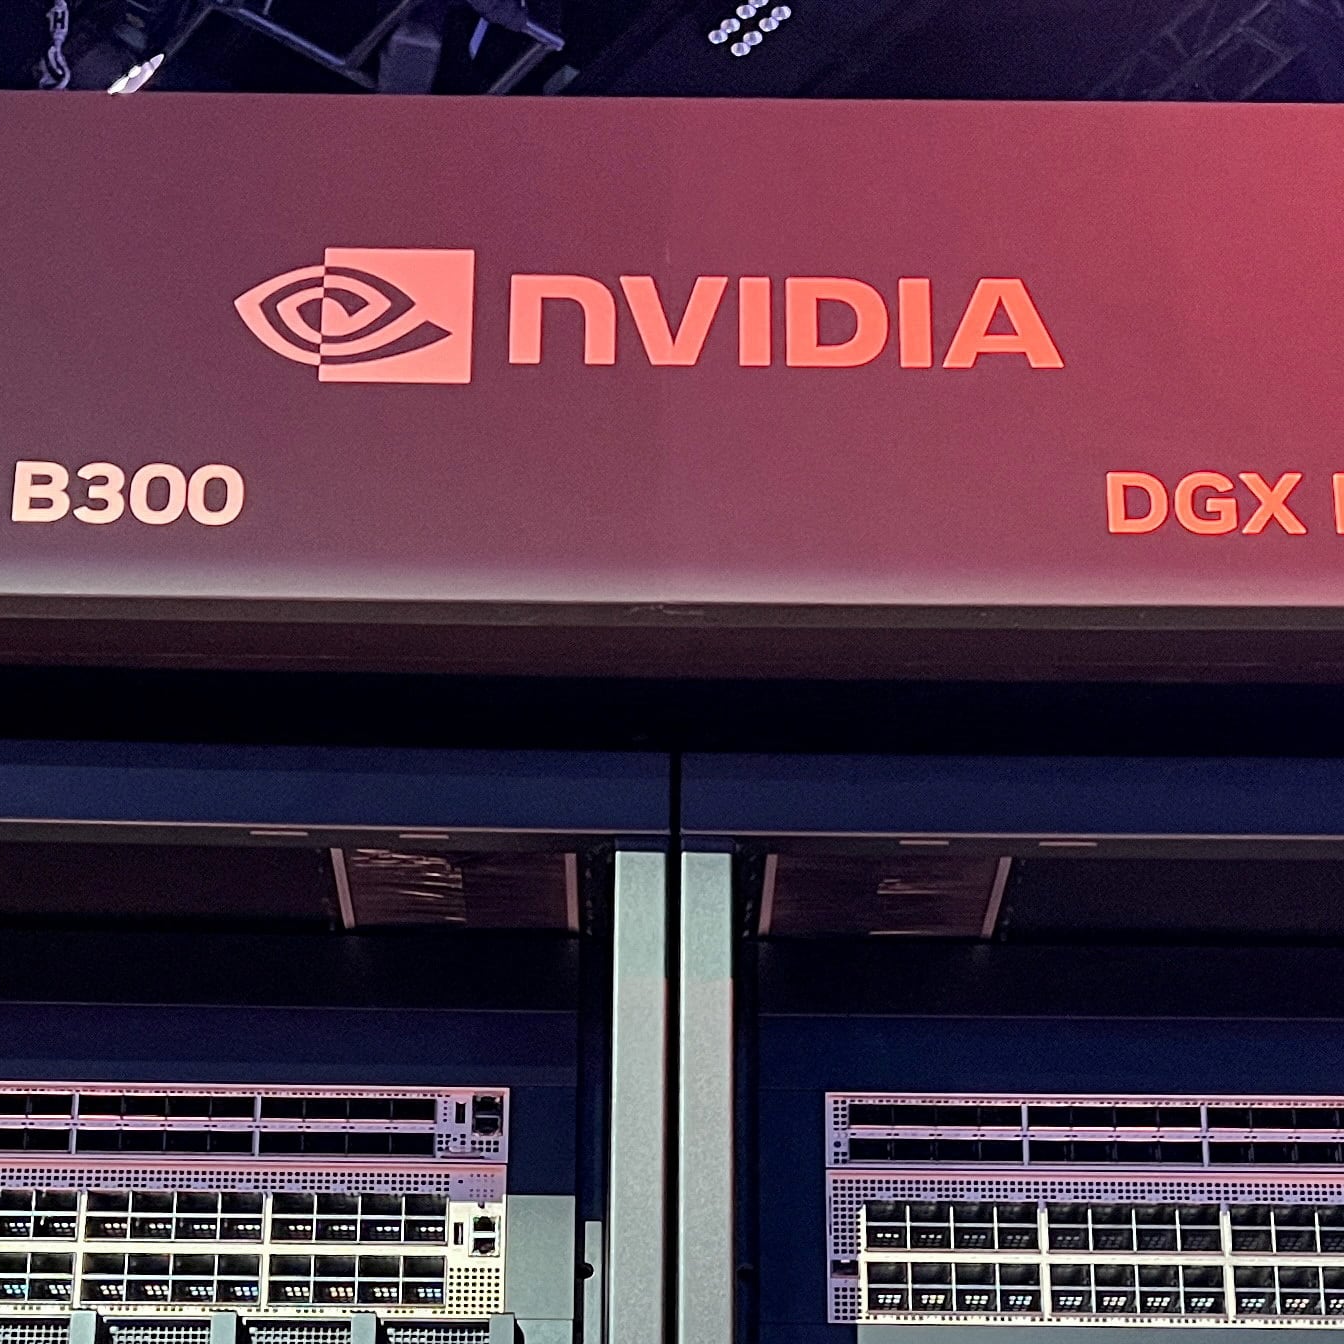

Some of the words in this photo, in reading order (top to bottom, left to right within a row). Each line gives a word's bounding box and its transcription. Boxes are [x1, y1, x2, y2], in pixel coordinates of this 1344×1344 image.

[509, 275, 1064, 369] NVIDIA
[11, 460, 245, 526] B300
[1106, 471, 1306, 535] DGX
